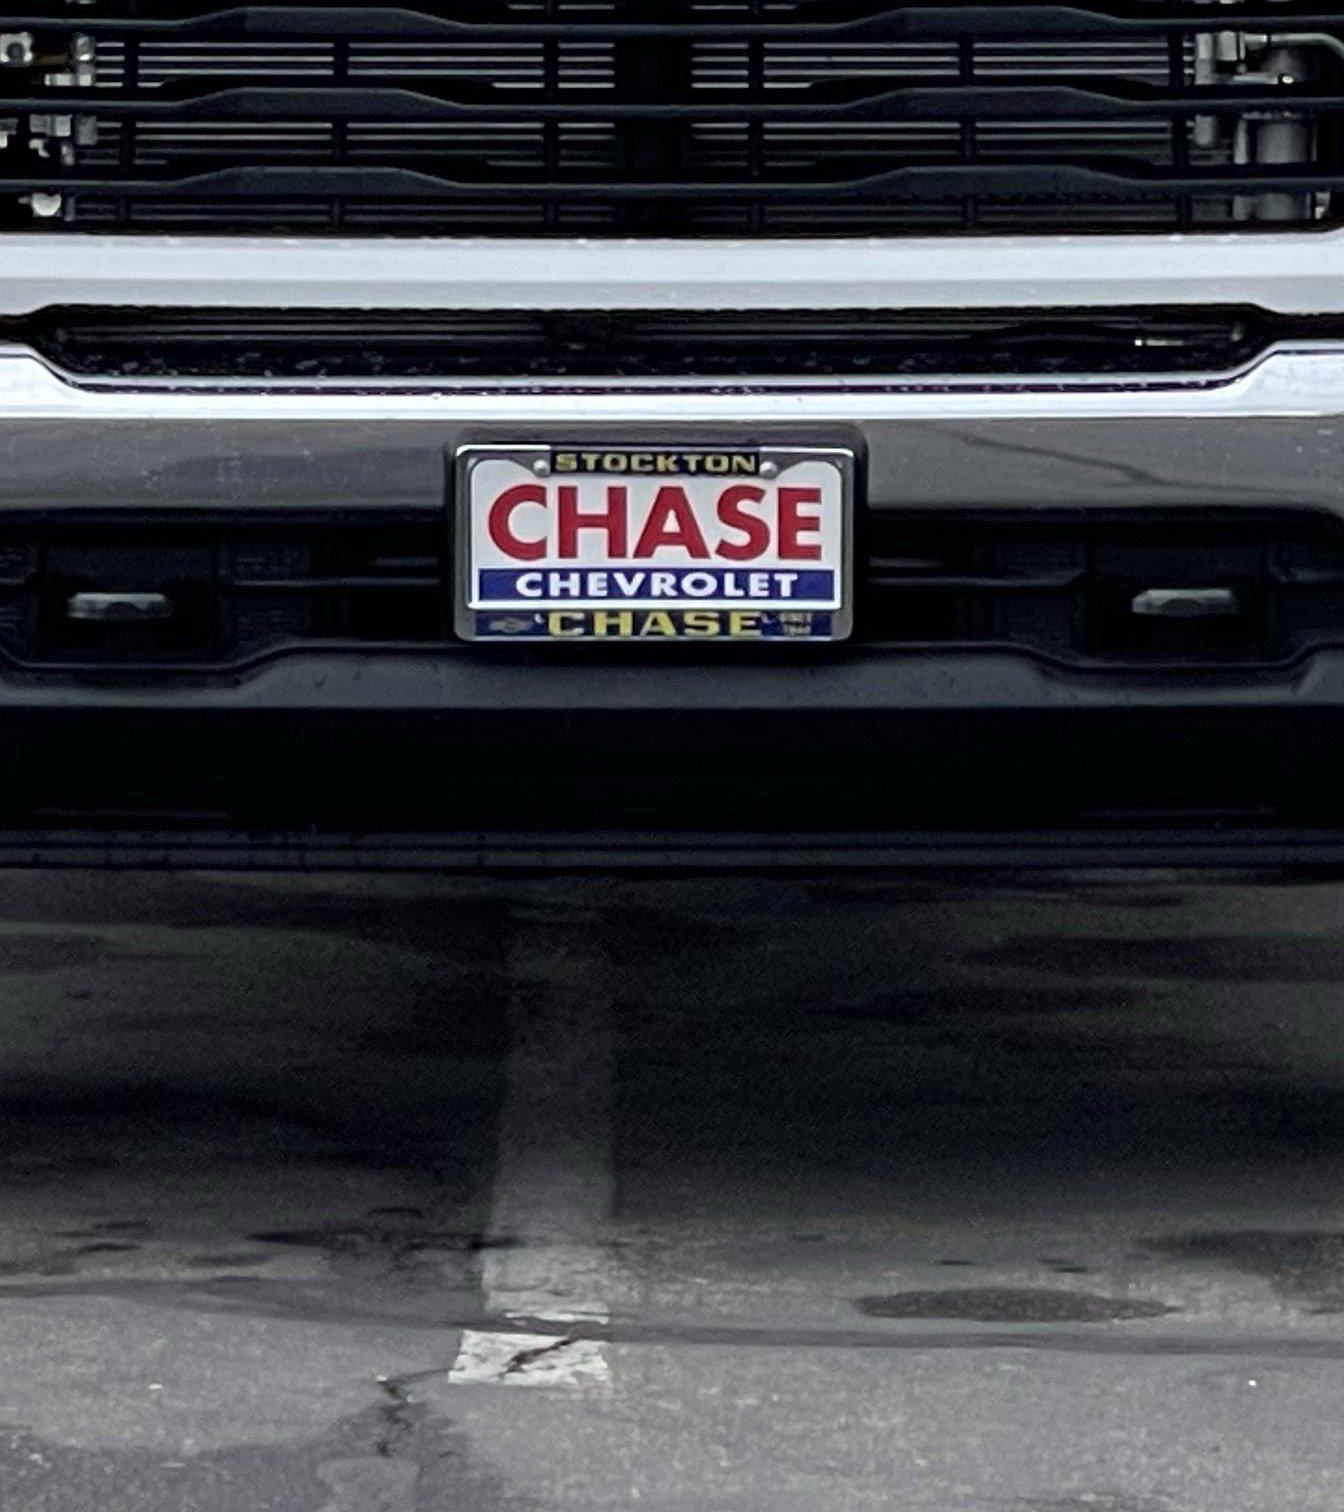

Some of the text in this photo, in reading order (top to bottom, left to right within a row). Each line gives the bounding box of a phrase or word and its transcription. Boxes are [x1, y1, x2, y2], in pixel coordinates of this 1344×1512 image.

[554, 453, 756, 473] STOCKTON
[488, 483, 822, 561] CHASE
[515, 572, 799, 598] CHEVROLET
[547, 610, 762, 637] CHASE
